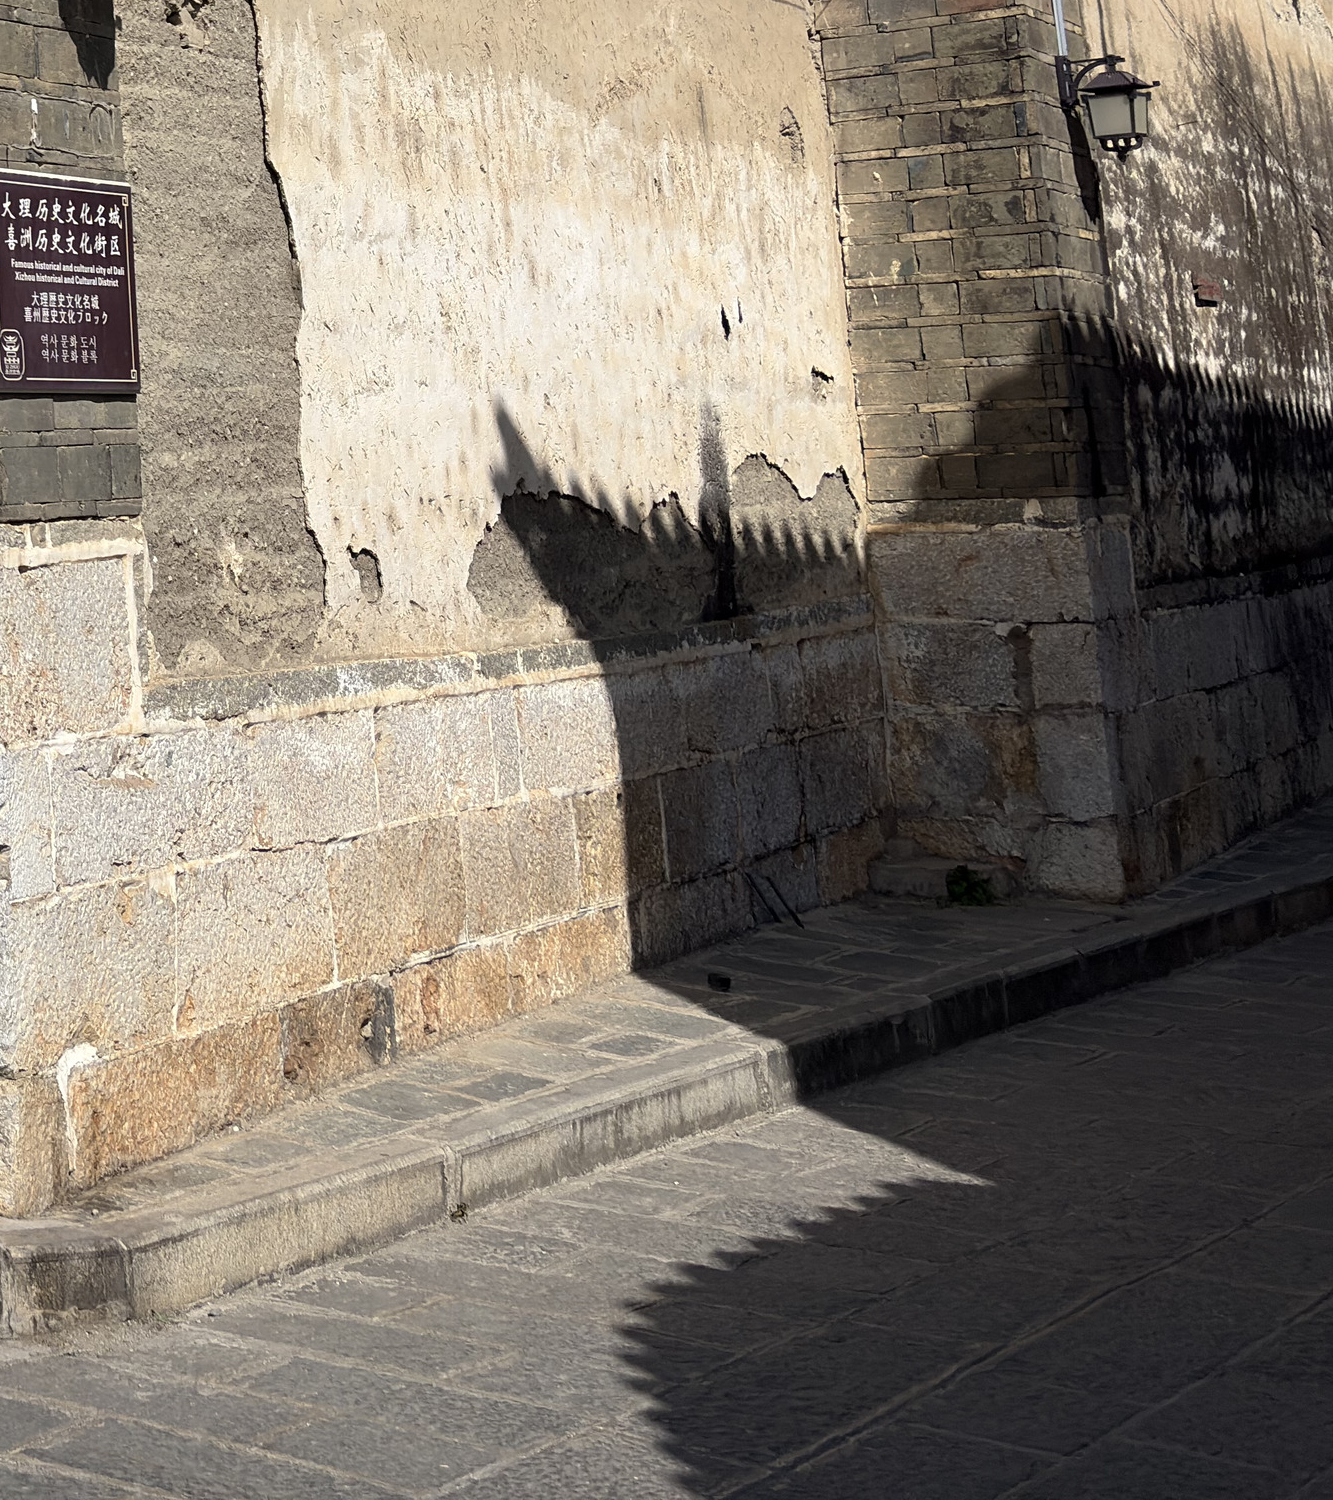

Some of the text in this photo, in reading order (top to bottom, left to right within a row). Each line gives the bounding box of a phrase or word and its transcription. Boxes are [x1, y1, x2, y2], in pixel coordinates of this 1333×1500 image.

[1, 192, 122, 229] 大理历史文化名城
[4, 223, 121, 257] 喜洲历史文化街区
[11, 258, 125, 276] Famous historical and cultural city of Dali
[15, 271, 119, 287] Xizhou historical and Cultural District
[40, 333, 97, 349] 역사 문화 도시
[41, 348, 98, 364] 역사 문화 블록
